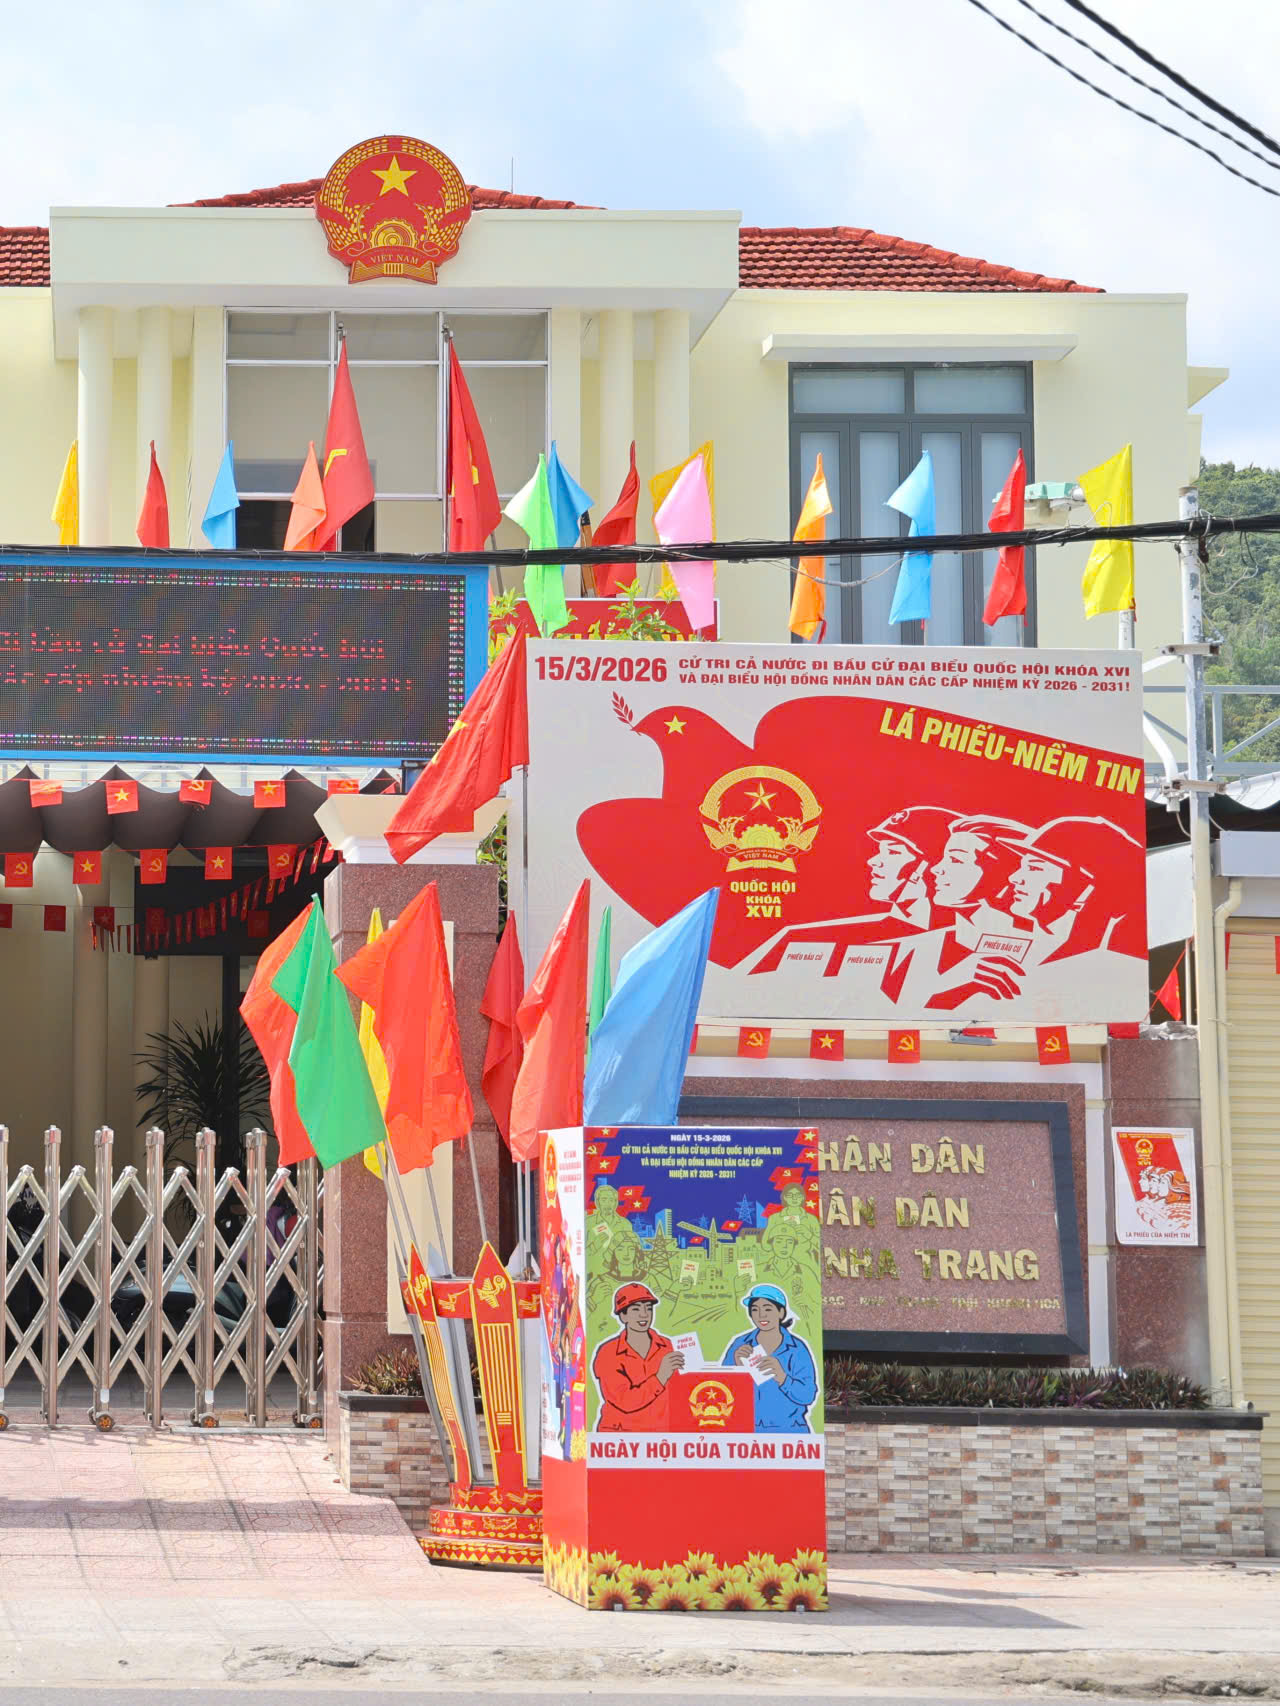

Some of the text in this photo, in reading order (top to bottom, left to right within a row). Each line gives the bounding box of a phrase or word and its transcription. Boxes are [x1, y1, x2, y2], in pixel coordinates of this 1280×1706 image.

[534, 656, 667, 682] 15/3/2026
[679, 655, 1130, 677] CỬ TRI CẢ NƯỚC ĐI BẦU CỬ ĐẠI BIỂU QUỐC HỘI KHÓA XVI
[679, 672, 697, 684] VÀ
[701, 673, 723, 686] ĐẠI
[728, 671, 760, 685] BIỂU
[763, 673, 786, 686] HỘI
[790, 672, 828, 685] ĐỒNG
[832, 674, 871, 686] NHÂN
[876, 675, 905, 686] DÂN
[909, 674, 936, 687] CÁC
[940, 674, 968, 687] CẤP
[973, 677, 1018, 691] NHIỆM
[1022, 677, 1040, 690] KỲ
[1044, 680, 1078, 691] 2026
[1091, 681, 1130, 692] 2031!
[879, 707, 916, 740] LÁ
[1095, 759, 1141, 794] TIN
[730, 878, 796, 895] QUỐC HỘI
[746, 895, 782, 904] KHÓA
[746, 905, 782, 918] XVI
[670, 1133, 691, 1142] NGÀY
[818, 1134, 985, 1174] HÂN DÂN
[819, 1187, 969, 1229] ÂN DÂN
[824, 1247, 1040, 1281] NHA TRANG
[590, 1435, 821, 1462] NGÀY HỘI CỦA TOÀN DÂN
